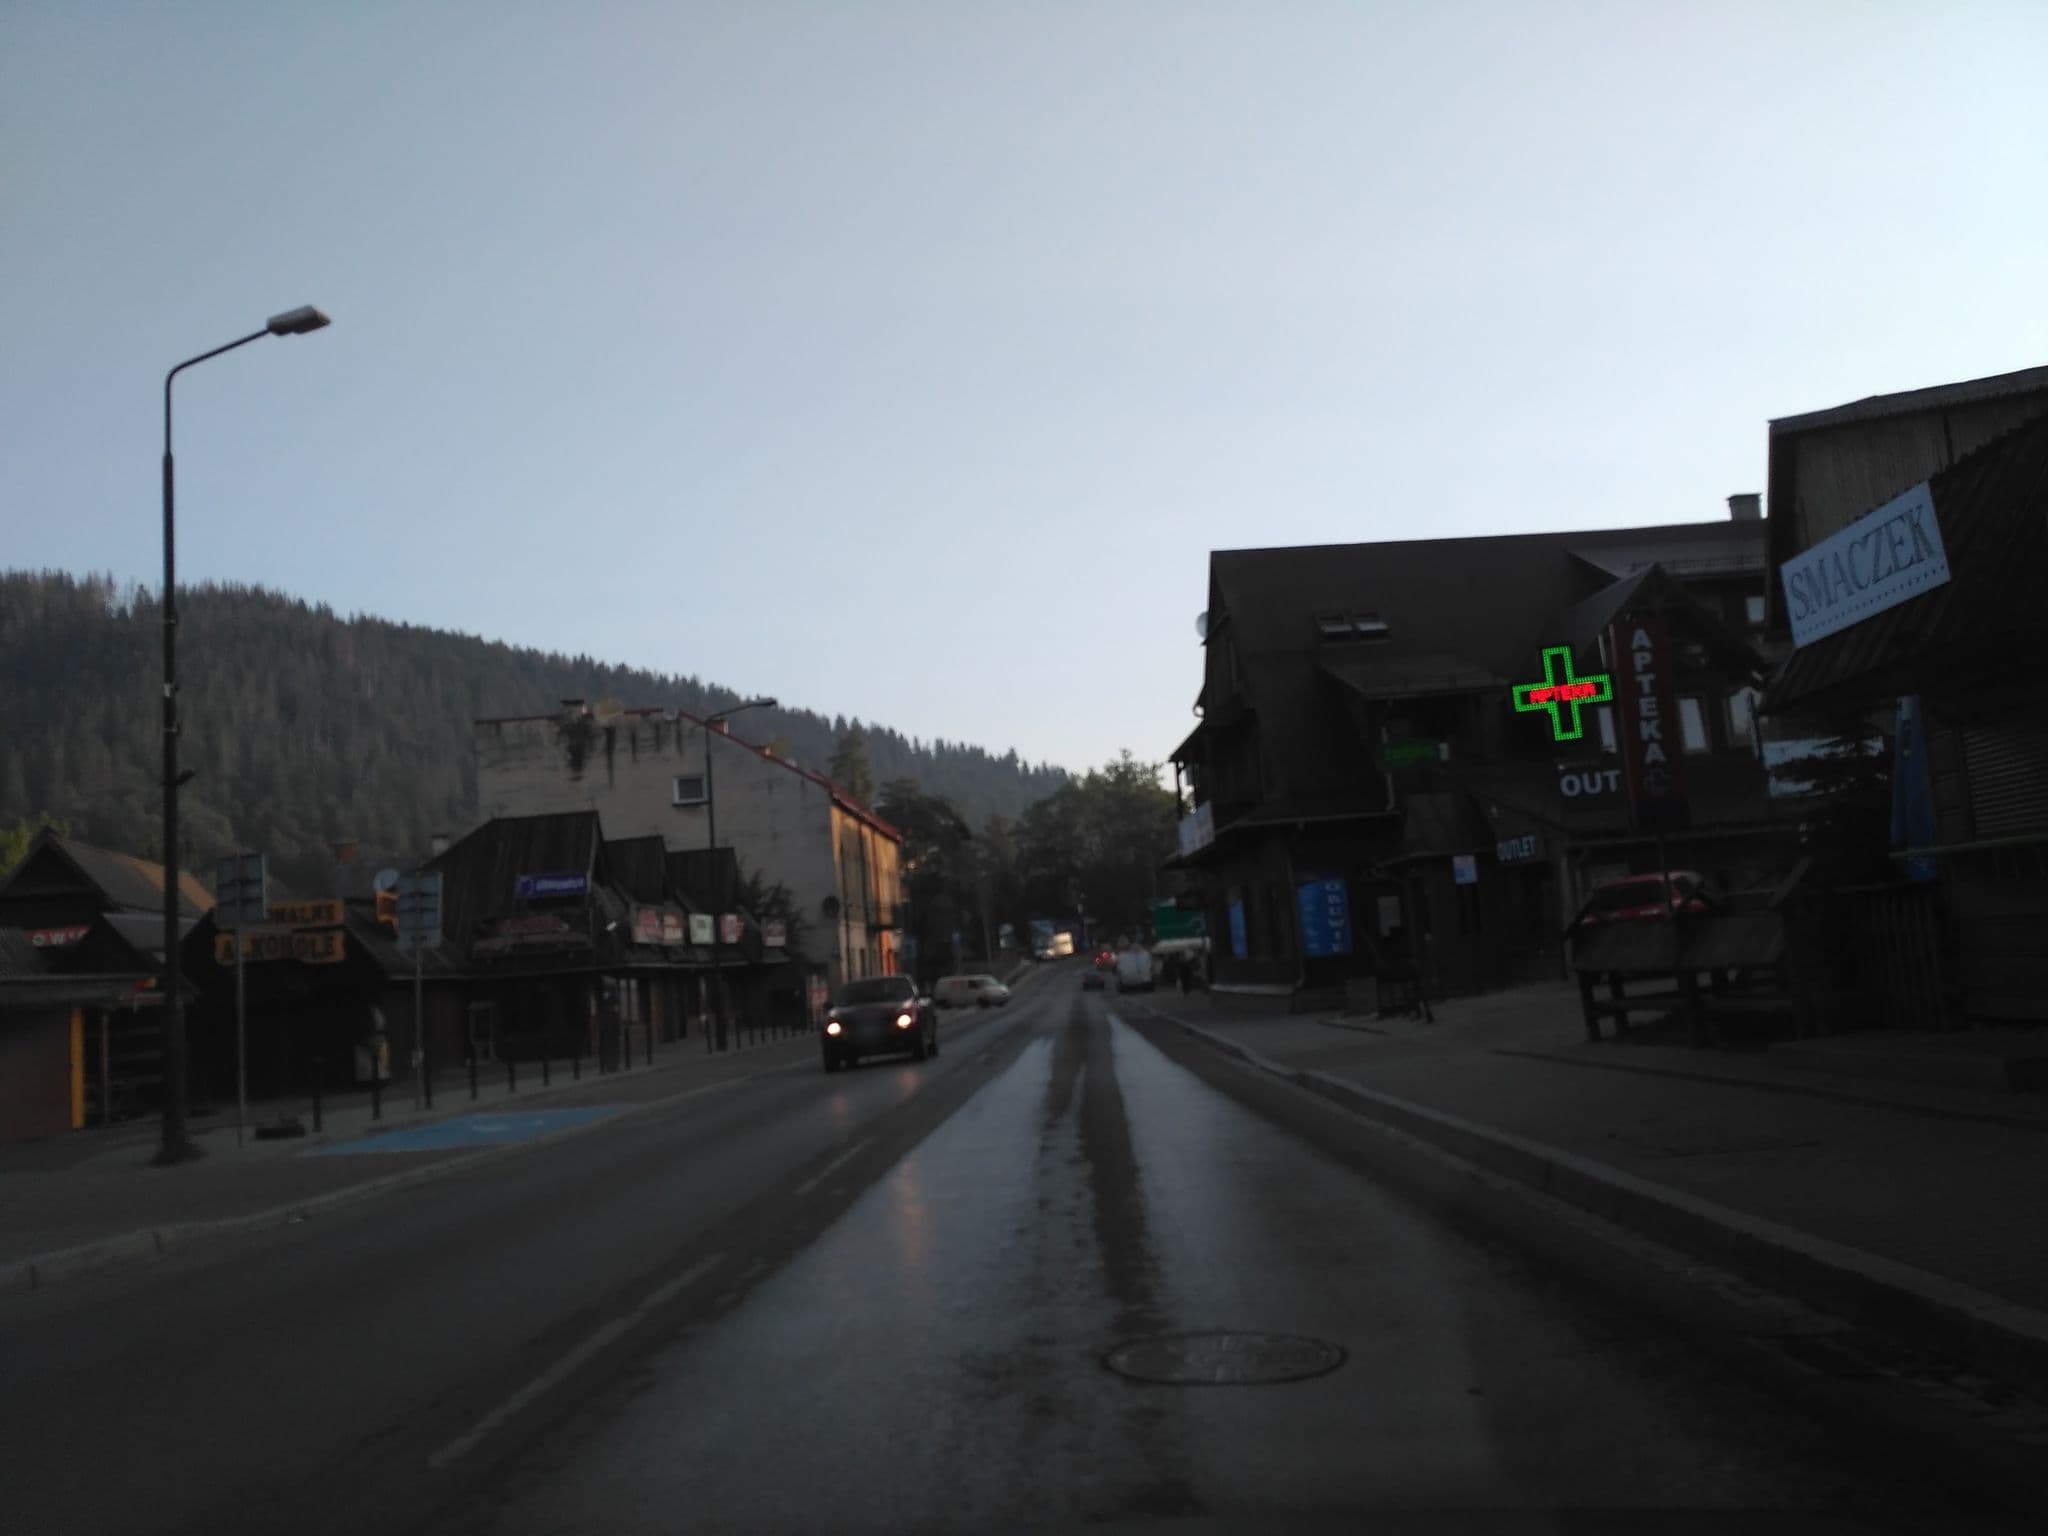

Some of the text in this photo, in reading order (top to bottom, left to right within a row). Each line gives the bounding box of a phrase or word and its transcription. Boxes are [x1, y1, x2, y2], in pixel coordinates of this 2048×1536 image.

[1791, 504, 1934, 621] SMACZEK
[1529, 681, 1598, 704] APTEKA
[1631, 628, 1668, 764] APTEKA
[1560, 769, 1621, 797] OUT
[1497, 835, 1536, 862] OUTLET
